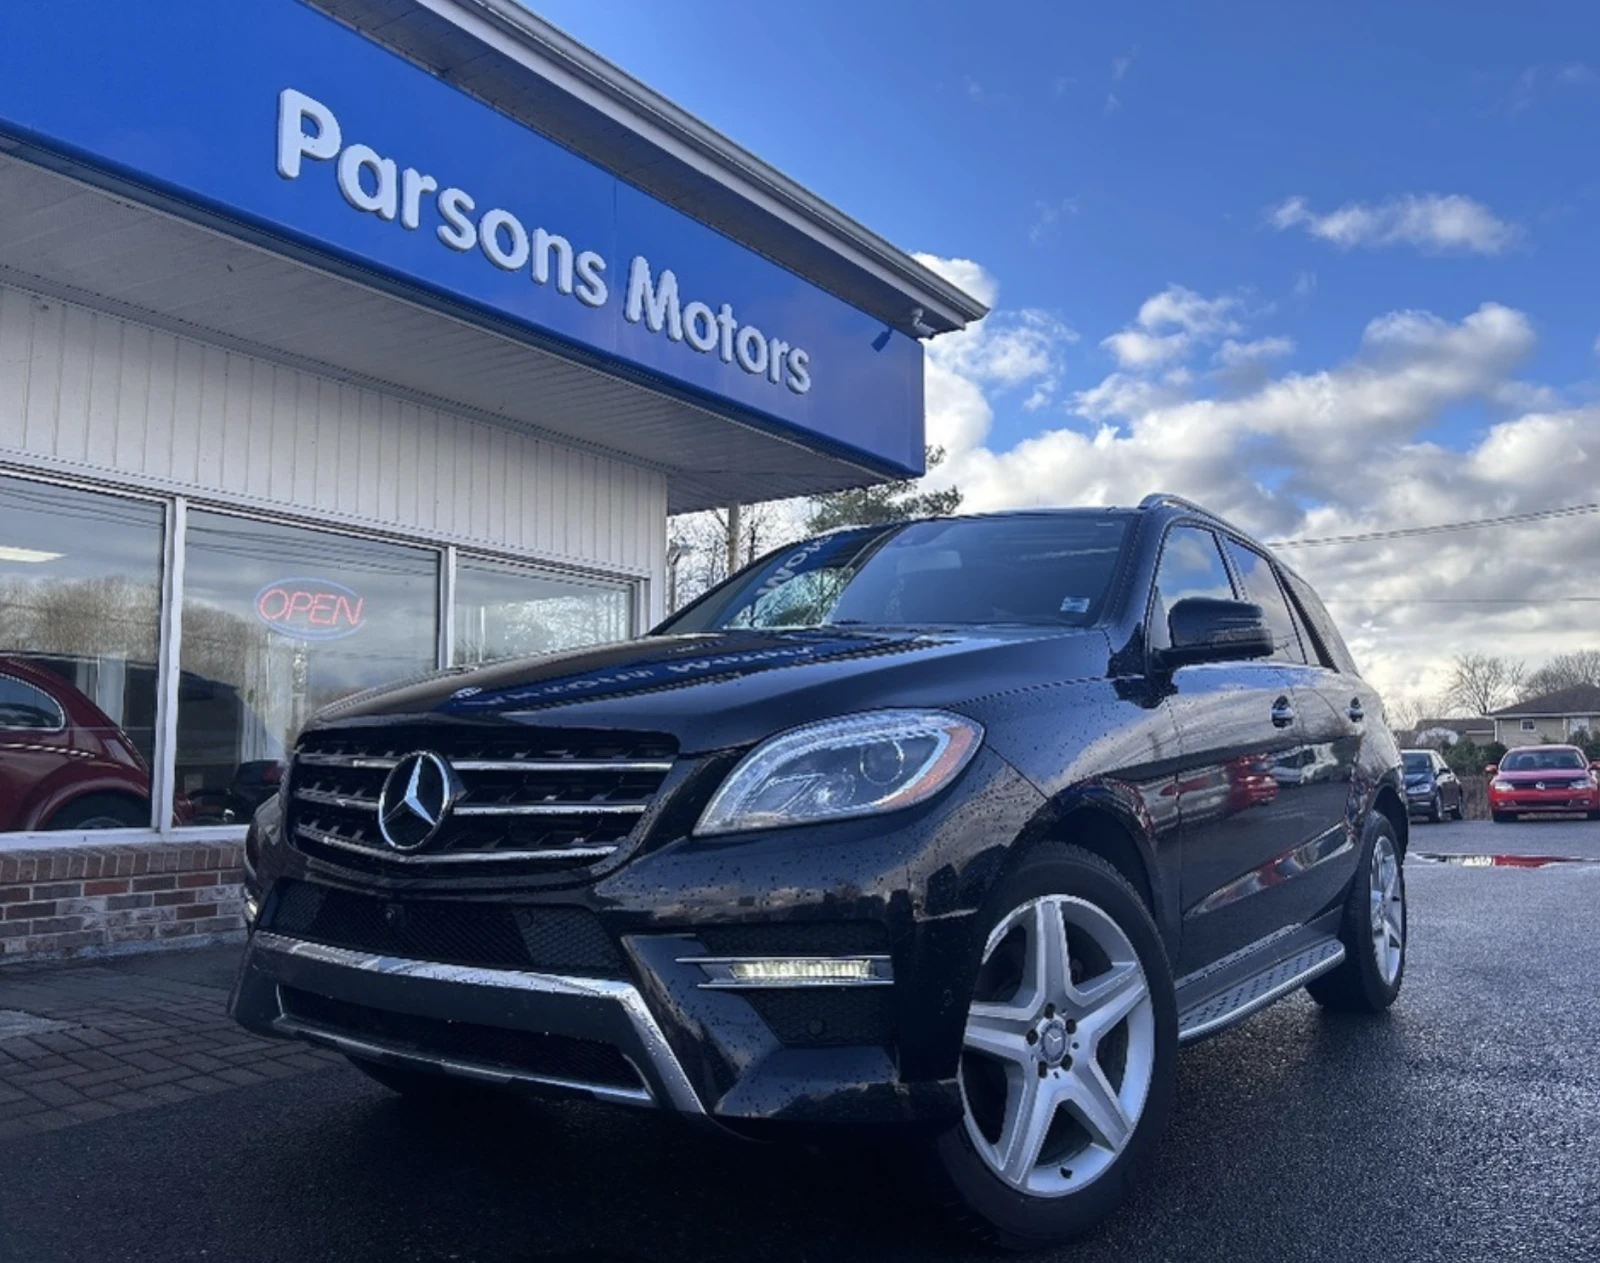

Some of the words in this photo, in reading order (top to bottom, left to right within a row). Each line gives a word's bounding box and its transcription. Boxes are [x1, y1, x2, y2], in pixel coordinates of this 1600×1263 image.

[277, 87, 608, 306] Parsons
[624, 255, 811, 394] Motors
[259, 588, 363, 626] OPEN
